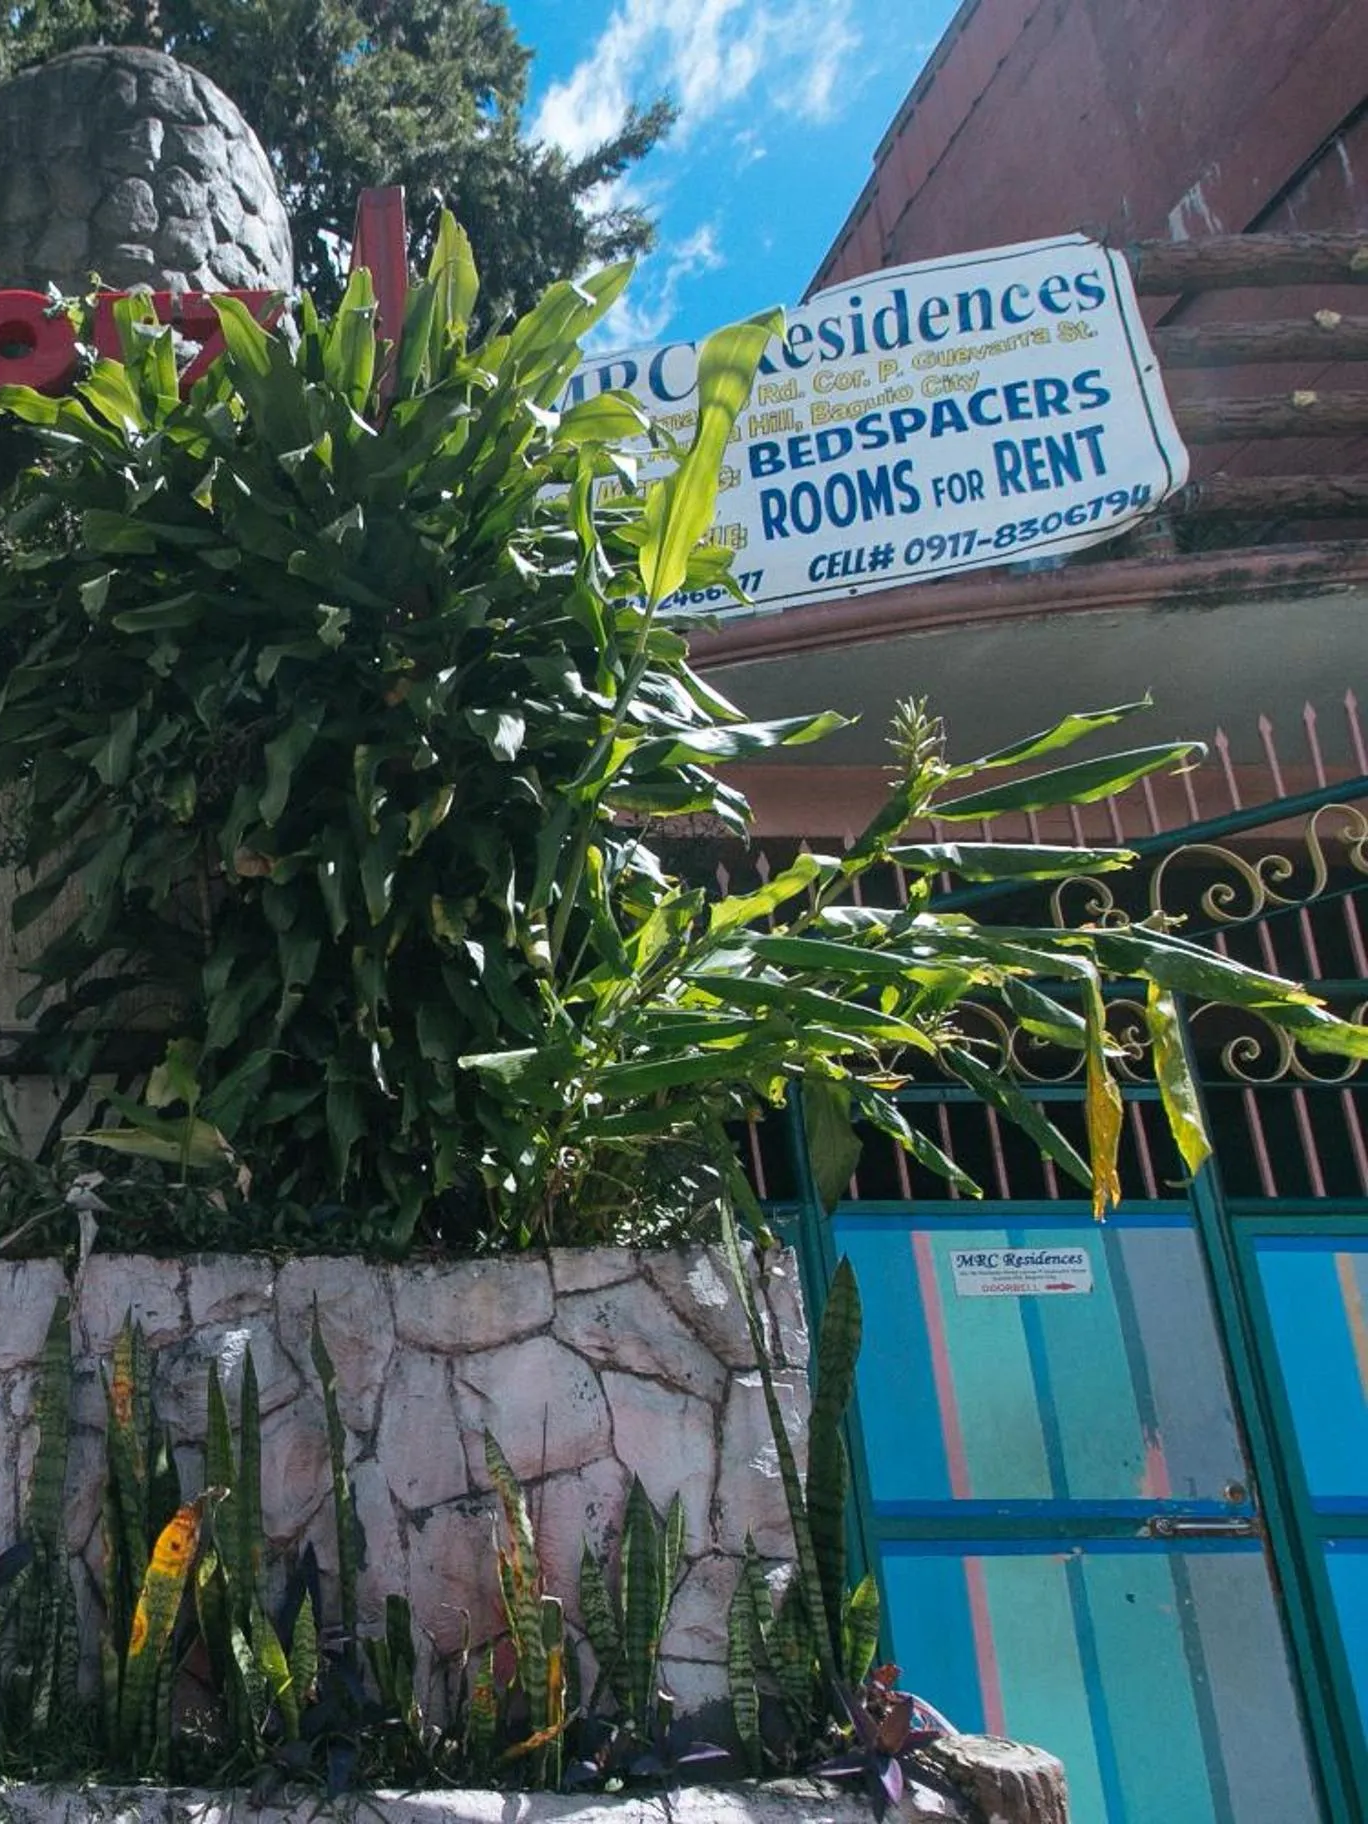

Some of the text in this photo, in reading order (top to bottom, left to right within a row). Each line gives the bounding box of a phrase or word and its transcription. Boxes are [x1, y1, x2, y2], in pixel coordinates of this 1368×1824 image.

[757, 268, 1107, 376] esidences
[758, 379, 805, 406] Rd.
[813, 368, 871, 393] Cor.
[878, 358, 904, 383] P.
[912, 325, 1051, 371] Guevarra
[1056, 319, 1098, 343] St.
[747, 368, 1112, 479] BEDSPACERS
[748, 407, 804, 436] Hill,
[811, 382, 914, 426] Baguio
[920, 371, 980, 398] City
[759, 458, 922, 541] ROOMS
[932, 468, 985, 508] FOR
[992, 424, 1109, 497] RENT
[808, 541, 895, 584] CELL#
[903, 483, 1152, 566] 0917-8306794
[955, 1251, 1084, 1269] MRC Residences
